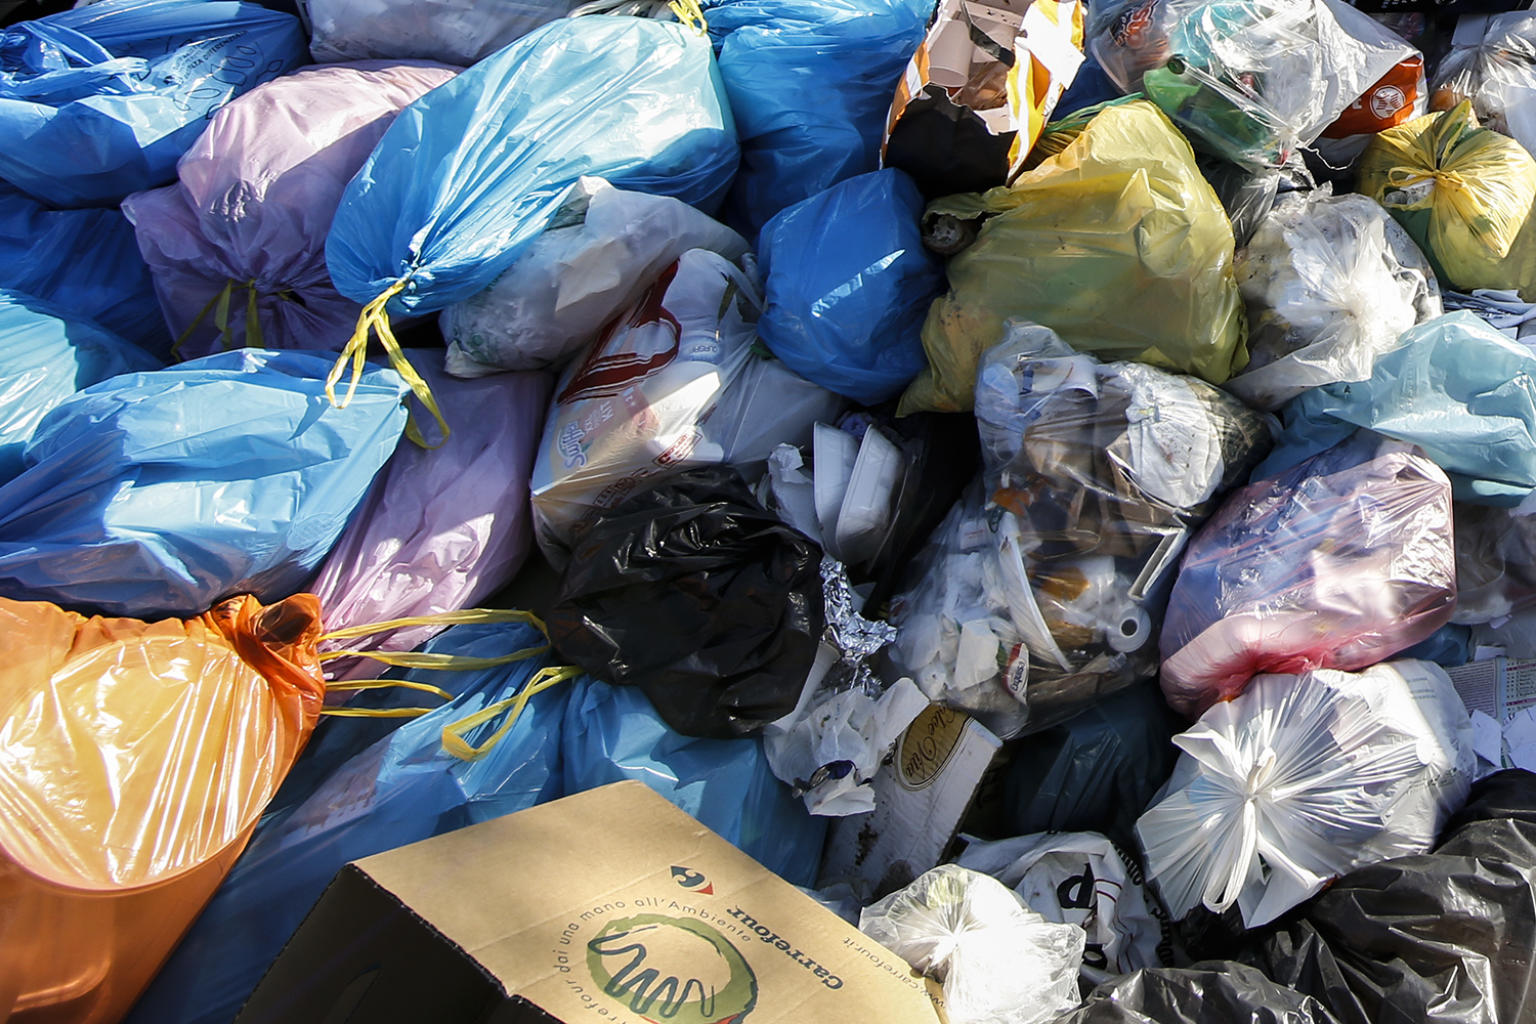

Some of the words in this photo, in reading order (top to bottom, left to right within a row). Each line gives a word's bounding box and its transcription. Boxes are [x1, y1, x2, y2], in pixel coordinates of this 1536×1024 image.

[580, 900, 626, 922] mano
[559, 922, 580, 945] una
[726, 903, 844, 992] Carrefour
[552, 948, 572, 973] dai
